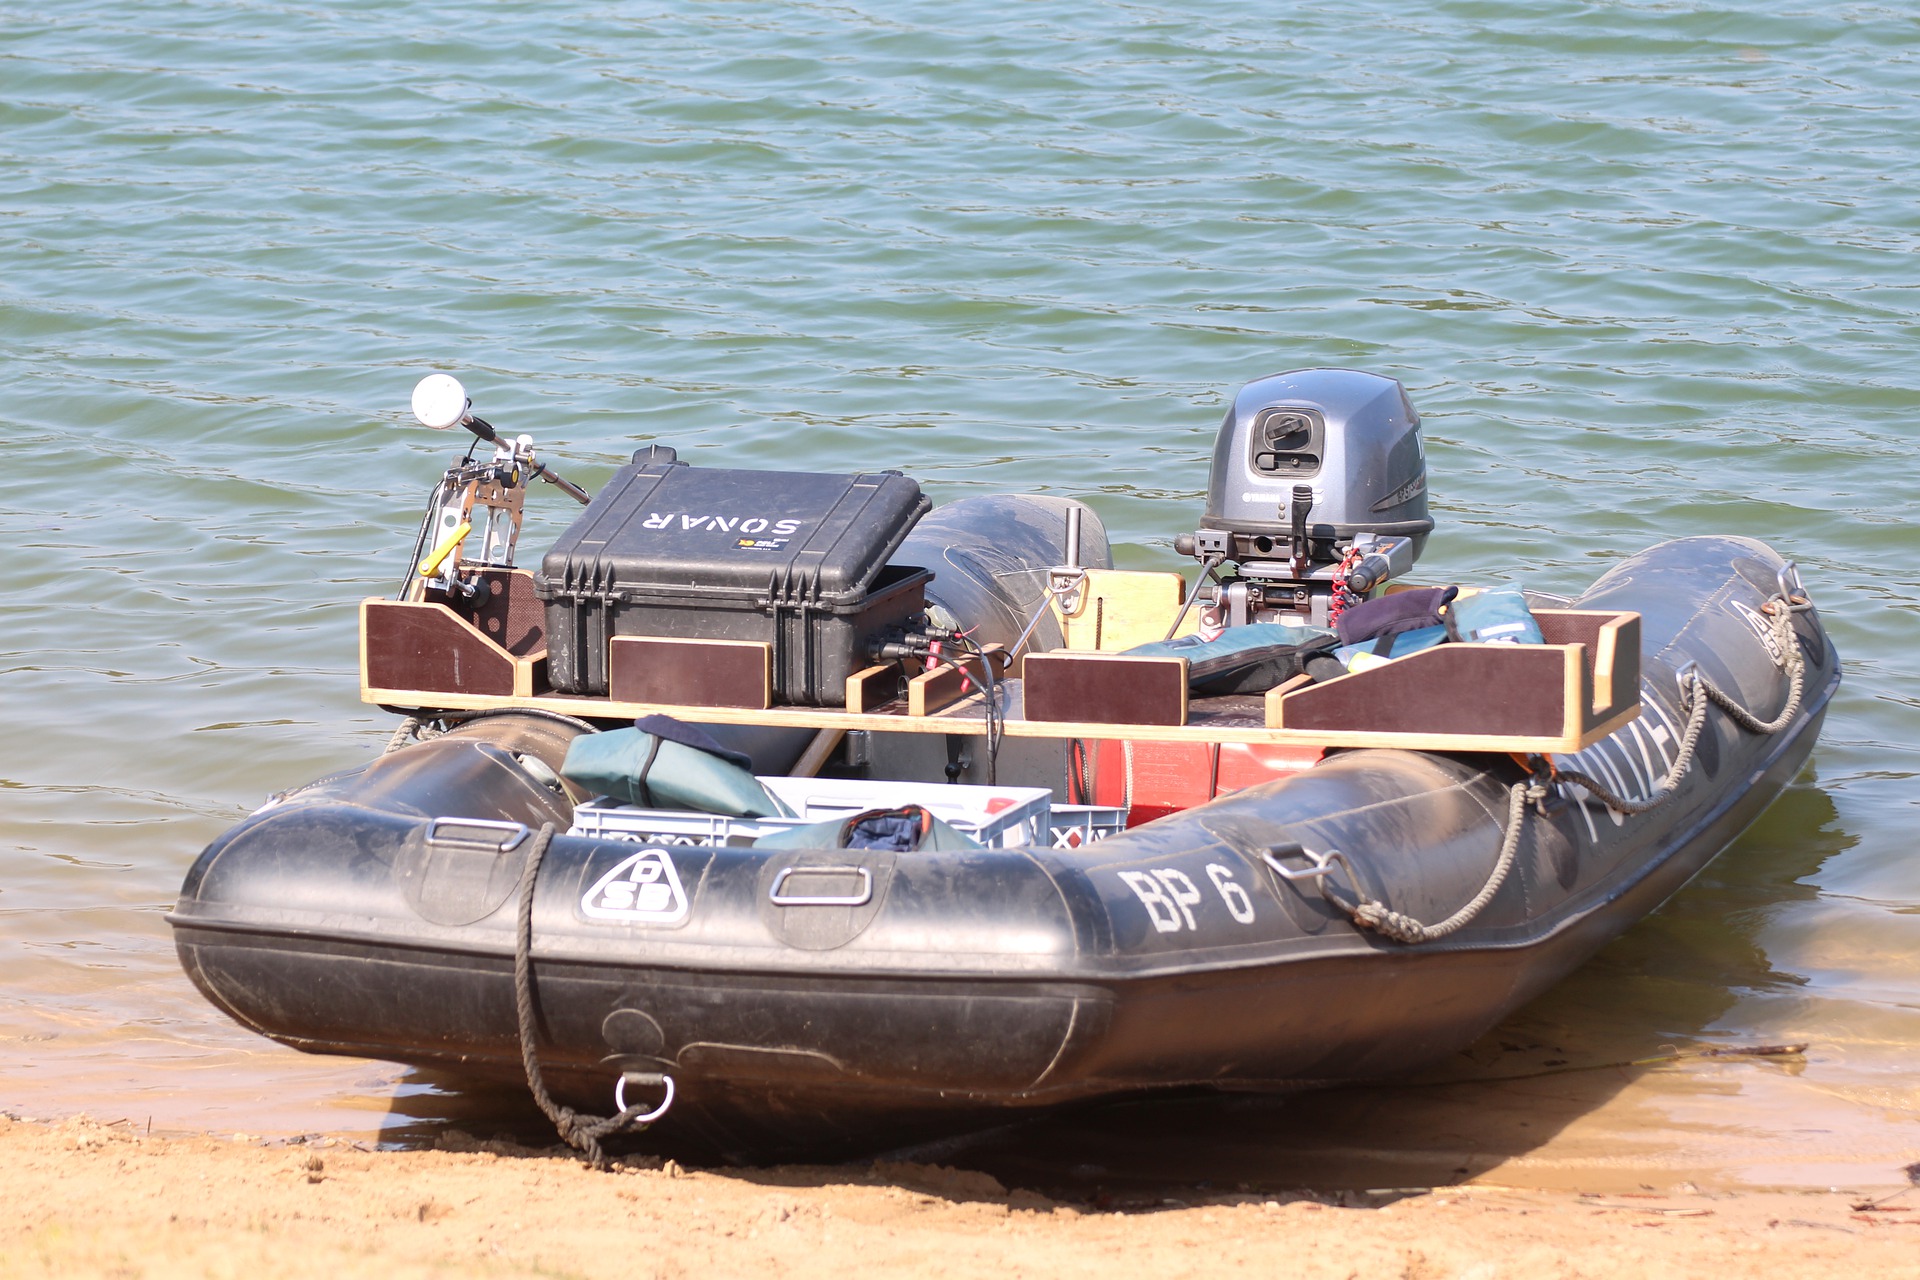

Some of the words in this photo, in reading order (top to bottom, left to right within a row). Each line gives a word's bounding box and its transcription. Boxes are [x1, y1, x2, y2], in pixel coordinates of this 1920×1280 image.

[1251, 493, 1281, 503] YAMAHA
[641, 512, 802, 535] SONAR
[600, 880, 672, 911] SB
[1116, 867, 1202, 933] BP
[1205, 863, 1256, 925] 6
